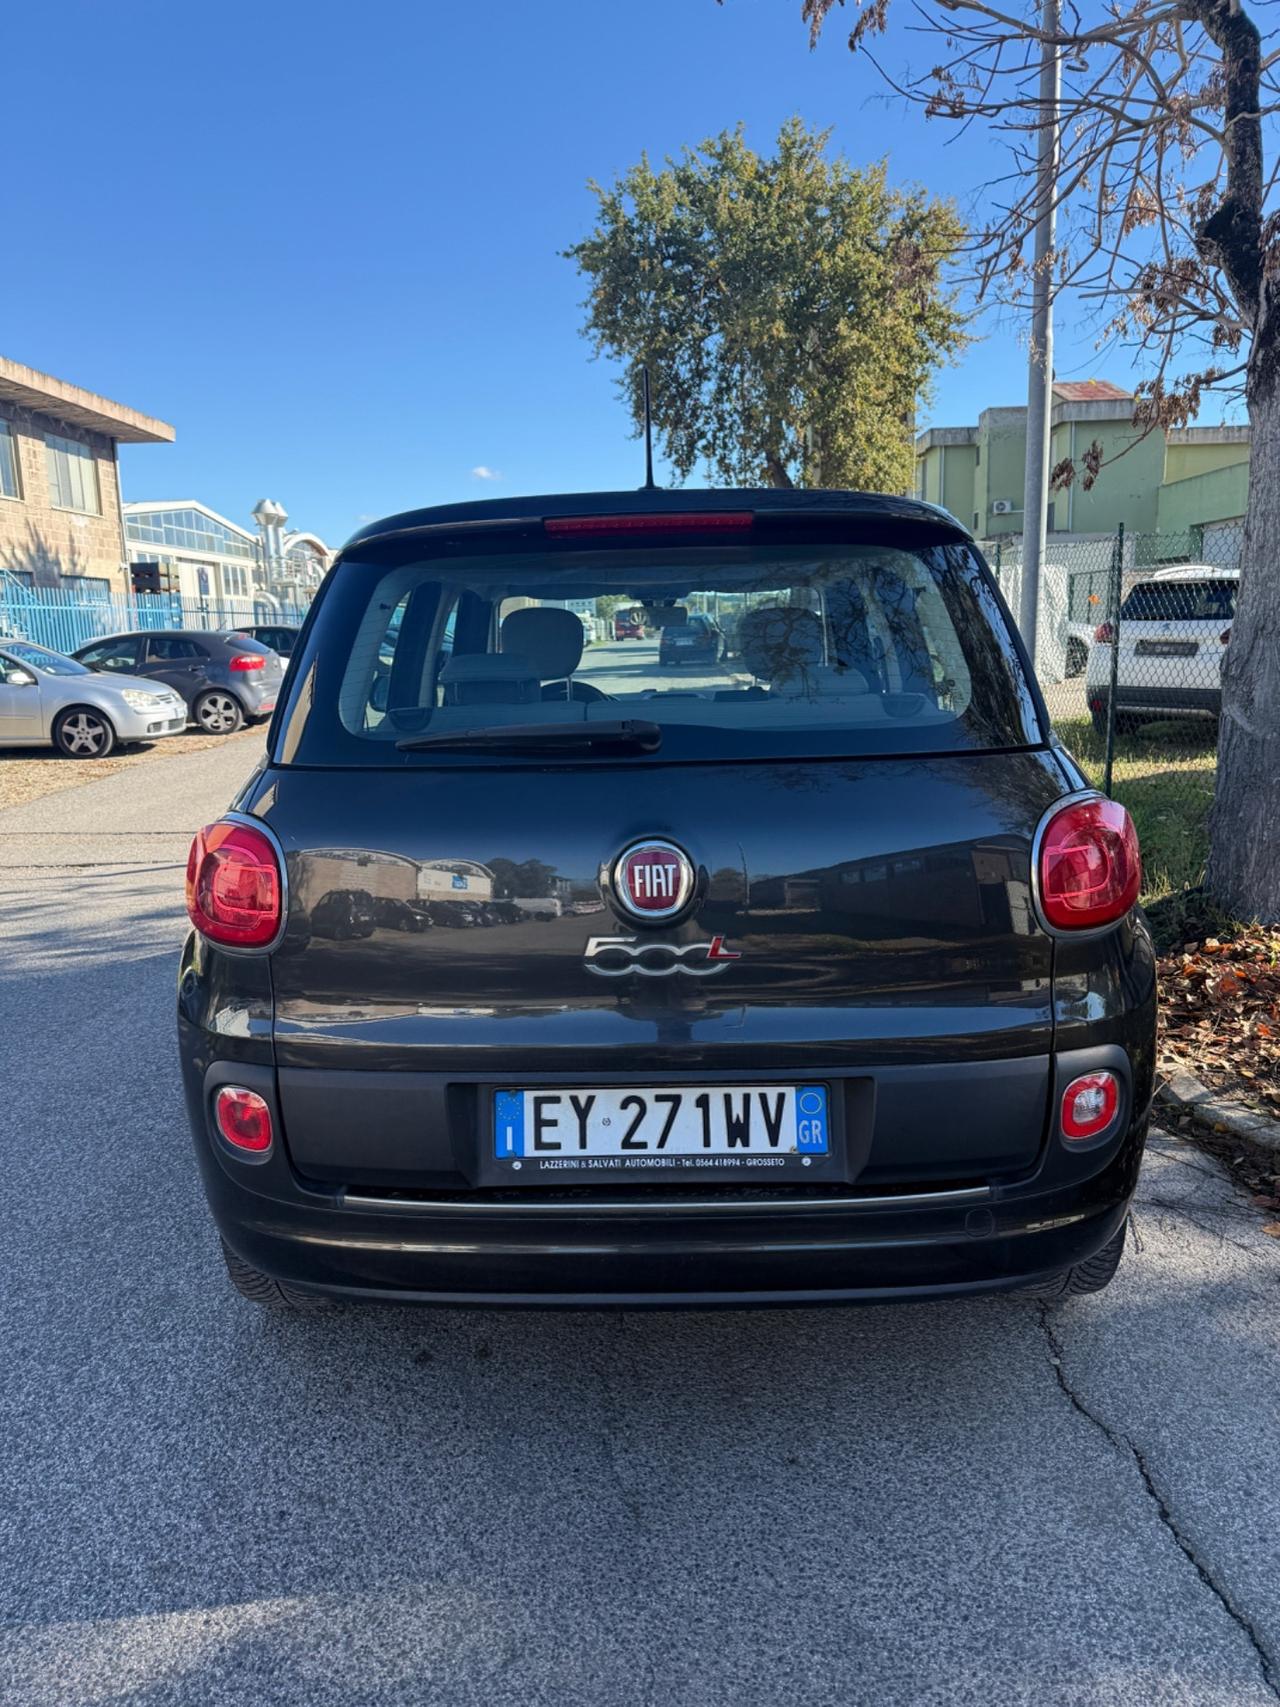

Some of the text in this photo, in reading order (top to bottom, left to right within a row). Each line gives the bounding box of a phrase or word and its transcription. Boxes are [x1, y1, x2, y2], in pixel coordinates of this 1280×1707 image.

[634, 864, 677, 898] FIAT
[533, 1092, 787, 1151] EY 271WV
[798, 1119, 823, 1144] GR
[539, 1159, 579, 1169] LAZZERINI
[588, 1159, 621, 1168] SALVATI
[624, 1158, 676, 1168] AUTOMOBILI
[746, 1157, 785, 1166] GROSSETO
